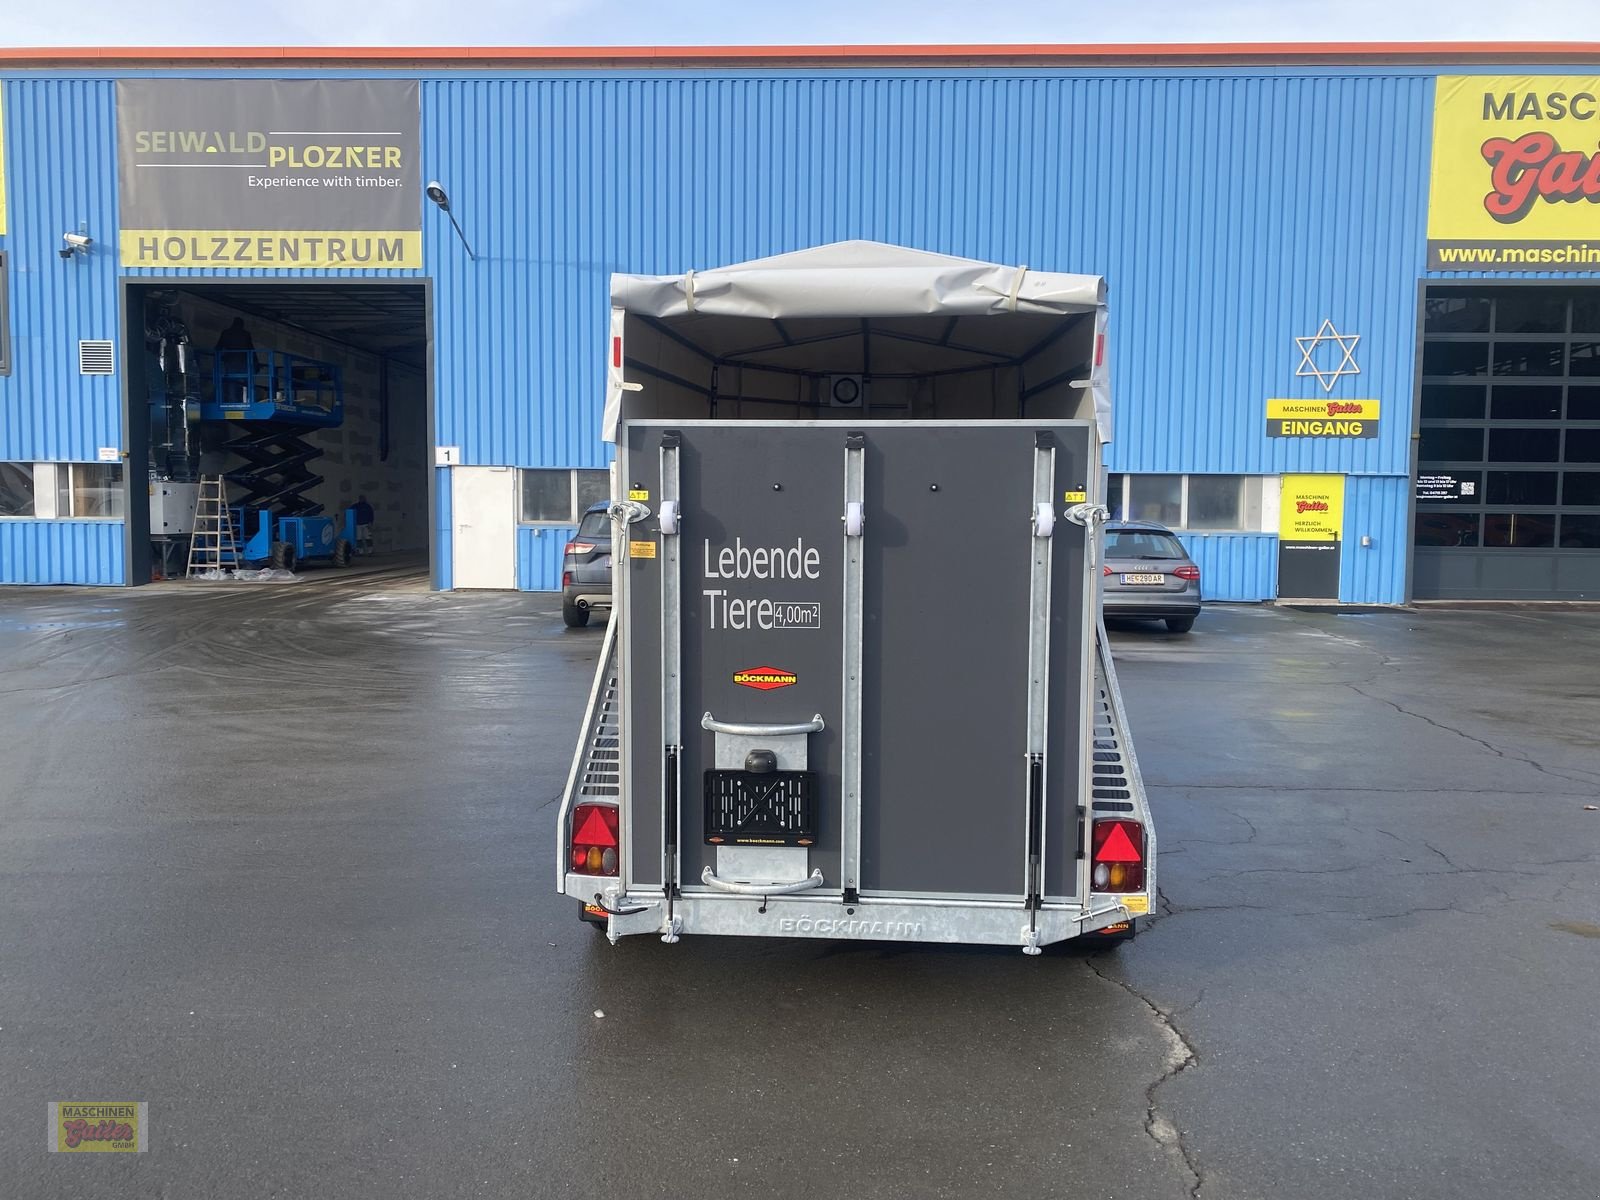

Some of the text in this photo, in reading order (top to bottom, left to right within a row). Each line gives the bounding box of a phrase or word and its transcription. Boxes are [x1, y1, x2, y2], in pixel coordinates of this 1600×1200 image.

[1482, 92, 1600, 121] MASC
[135, 131, 266, 154] SEIWALD
[248, 175, 403, 189] Experience with timber.
[138, 236, 404, 262] HOLZZENTRUM
[1438, 244, 1600, 264] www.maschin
[1281, 421, 1363, 436] EINGANG
[444, 450, 450, 462] 1
[704, 537, 820, 579] Lebende
[702, 589, 773, 629] Tiere
[734, 673, 797, 684] BÖCKMANN
[779, 915, 923, 937] BÖCKMANN
